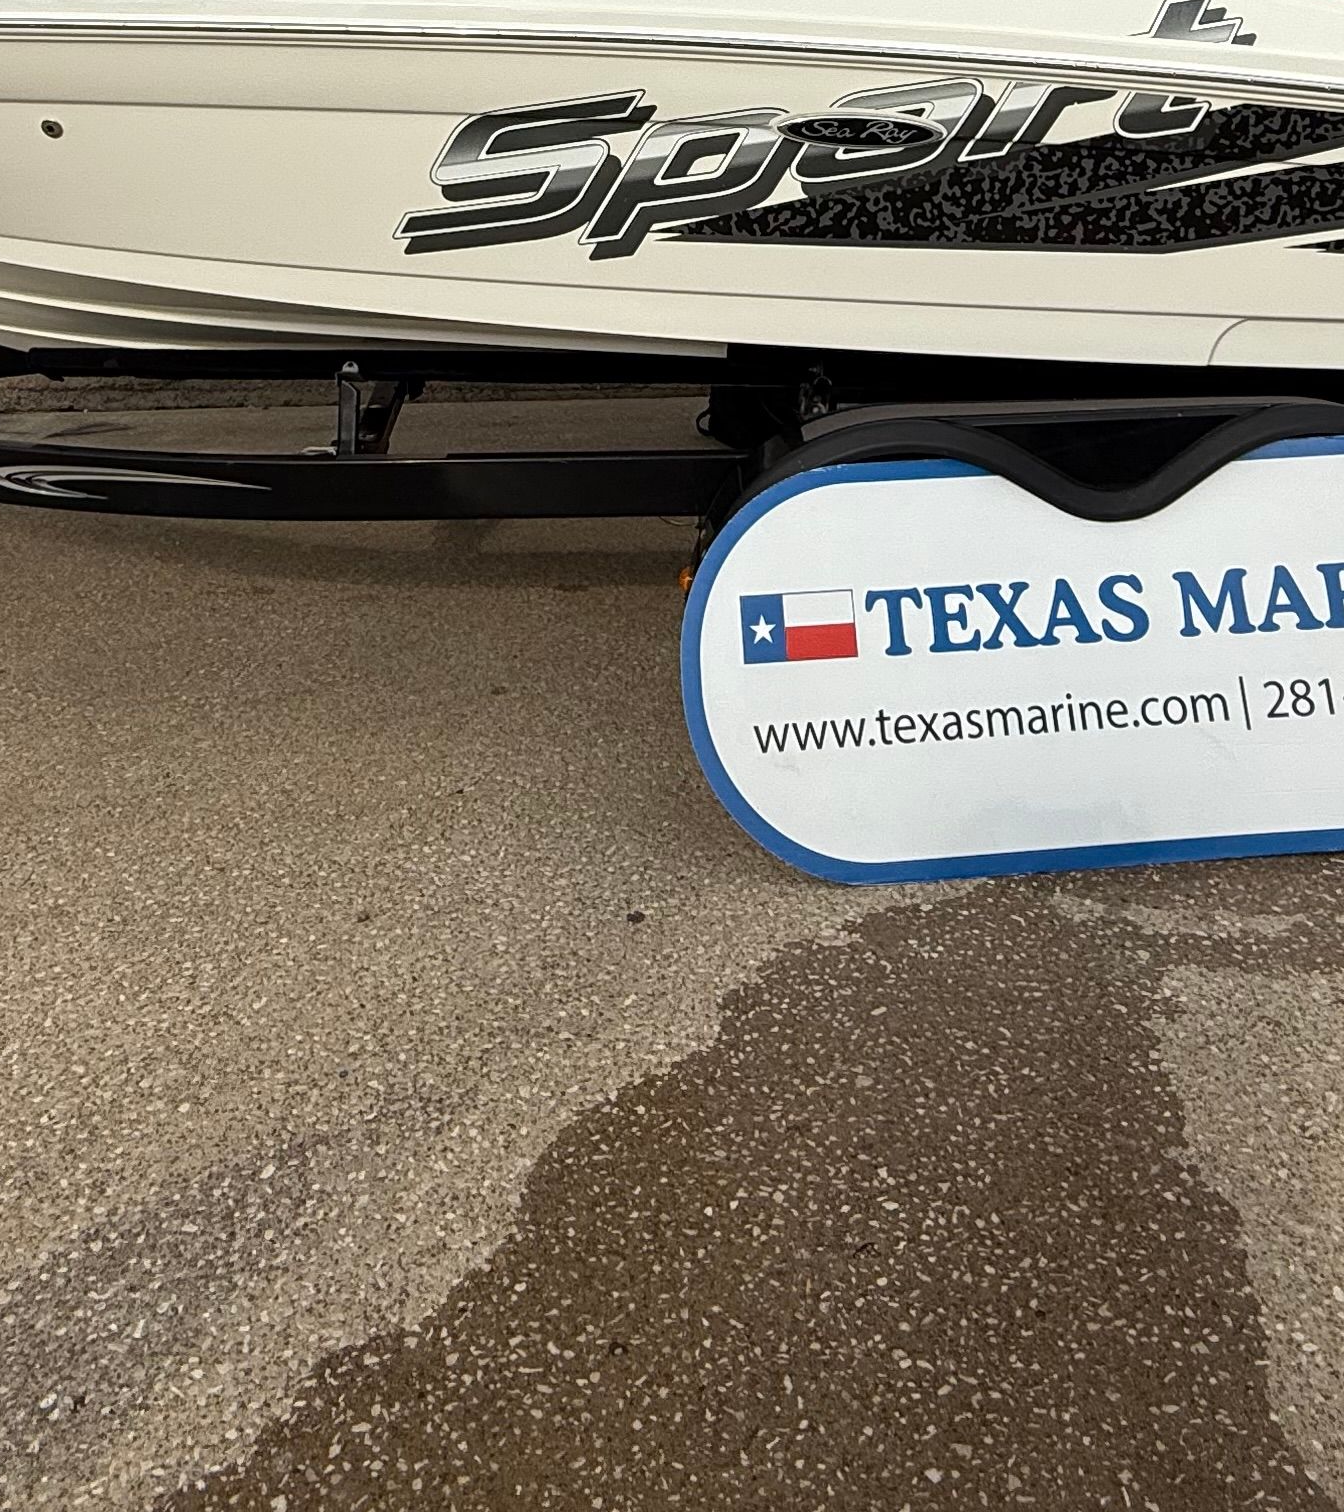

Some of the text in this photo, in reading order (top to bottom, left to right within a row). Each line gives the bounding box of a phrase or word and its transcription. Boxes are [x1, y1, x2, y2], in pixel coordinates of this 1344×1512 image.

[801, 120, 918, 144] Sea Ray
[864, 572, 1150, 657] TEXAS
[753, 690, 1231, 755] www.texasmarine.com
